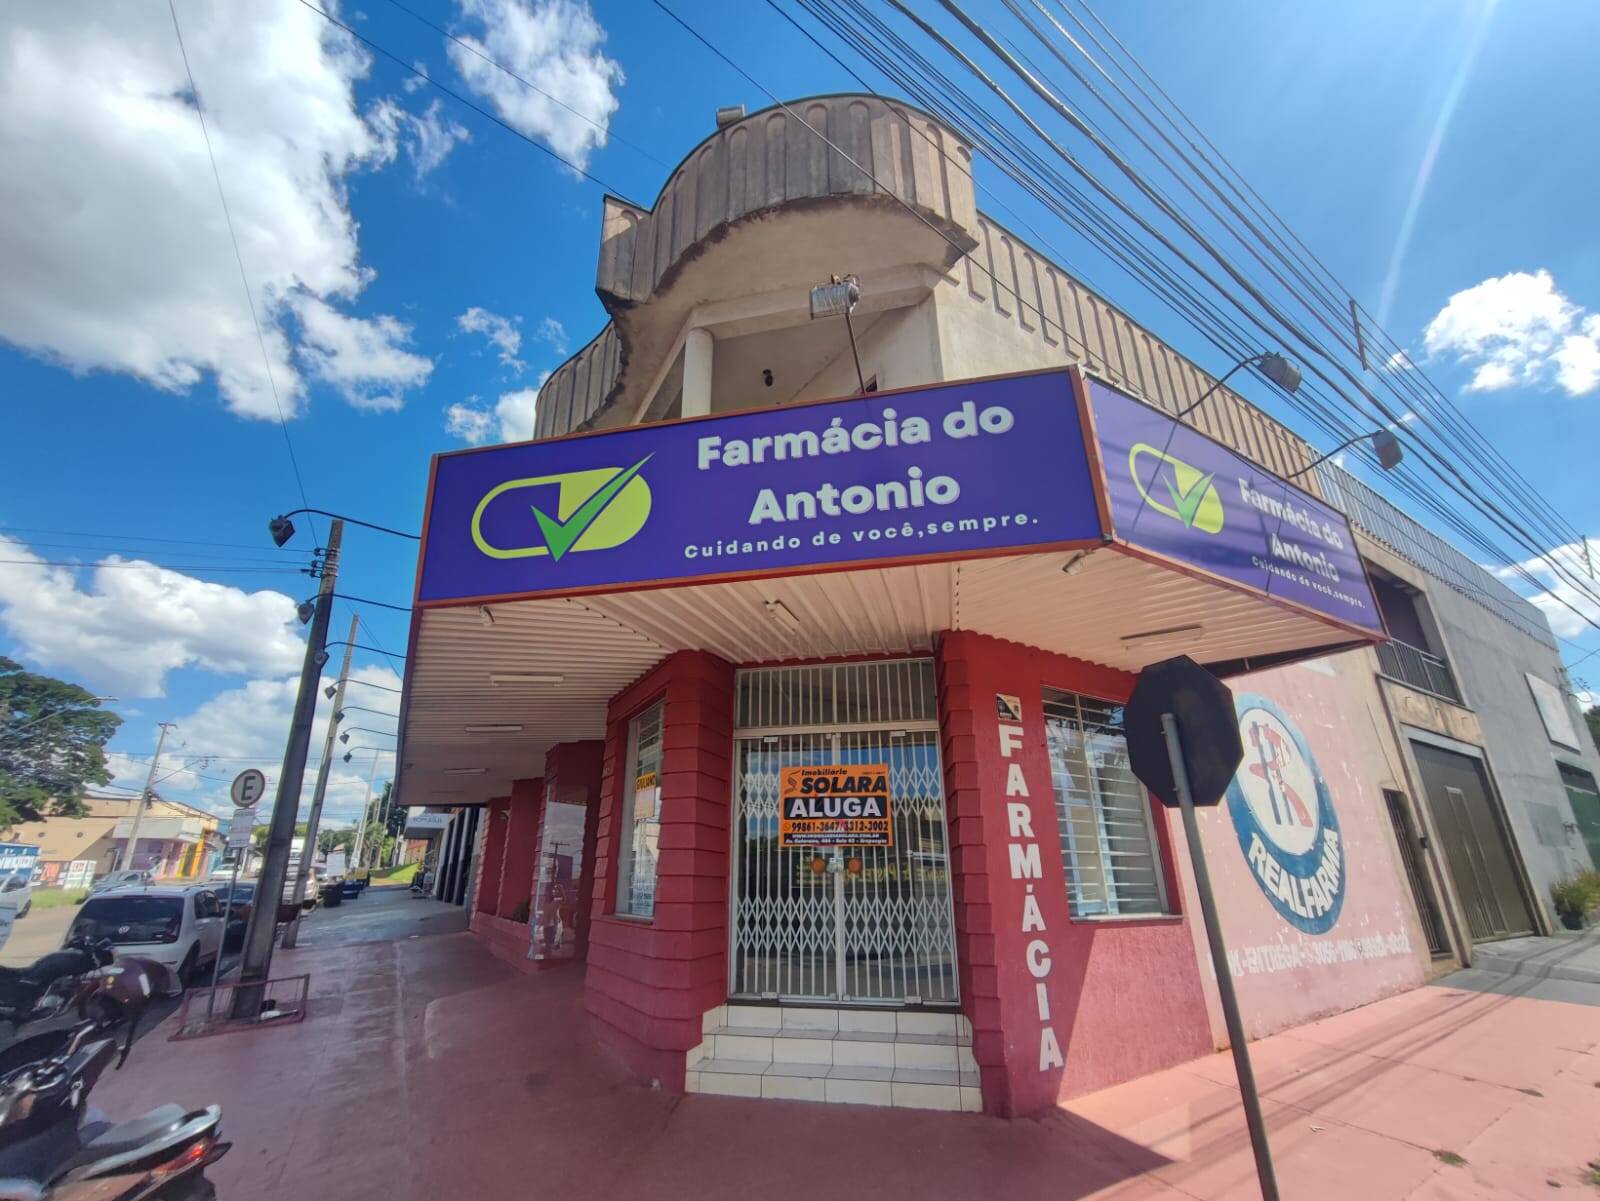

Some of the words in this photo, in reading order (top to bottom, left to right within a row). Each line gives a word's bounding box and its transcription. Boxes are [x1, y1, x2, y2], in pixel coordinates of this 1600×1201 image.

[698, 407, 931, 470] Farmácia
[943, 401, 1014, 439] do
[748, 466, 961, 525] Antonio
[1238, 477, 1322, 540] Farmácia
[1322, 523, 1344, 550] do
[684, 536, 801, 558] Cuidando
[812, 531, 841, 546] de
[1271, 532, 1340, 583] Antonio
[241, 775, 256, 801] E
[800, 775, 887, 794] SOLARA
[789, 797, 882, 818] ALUGA
